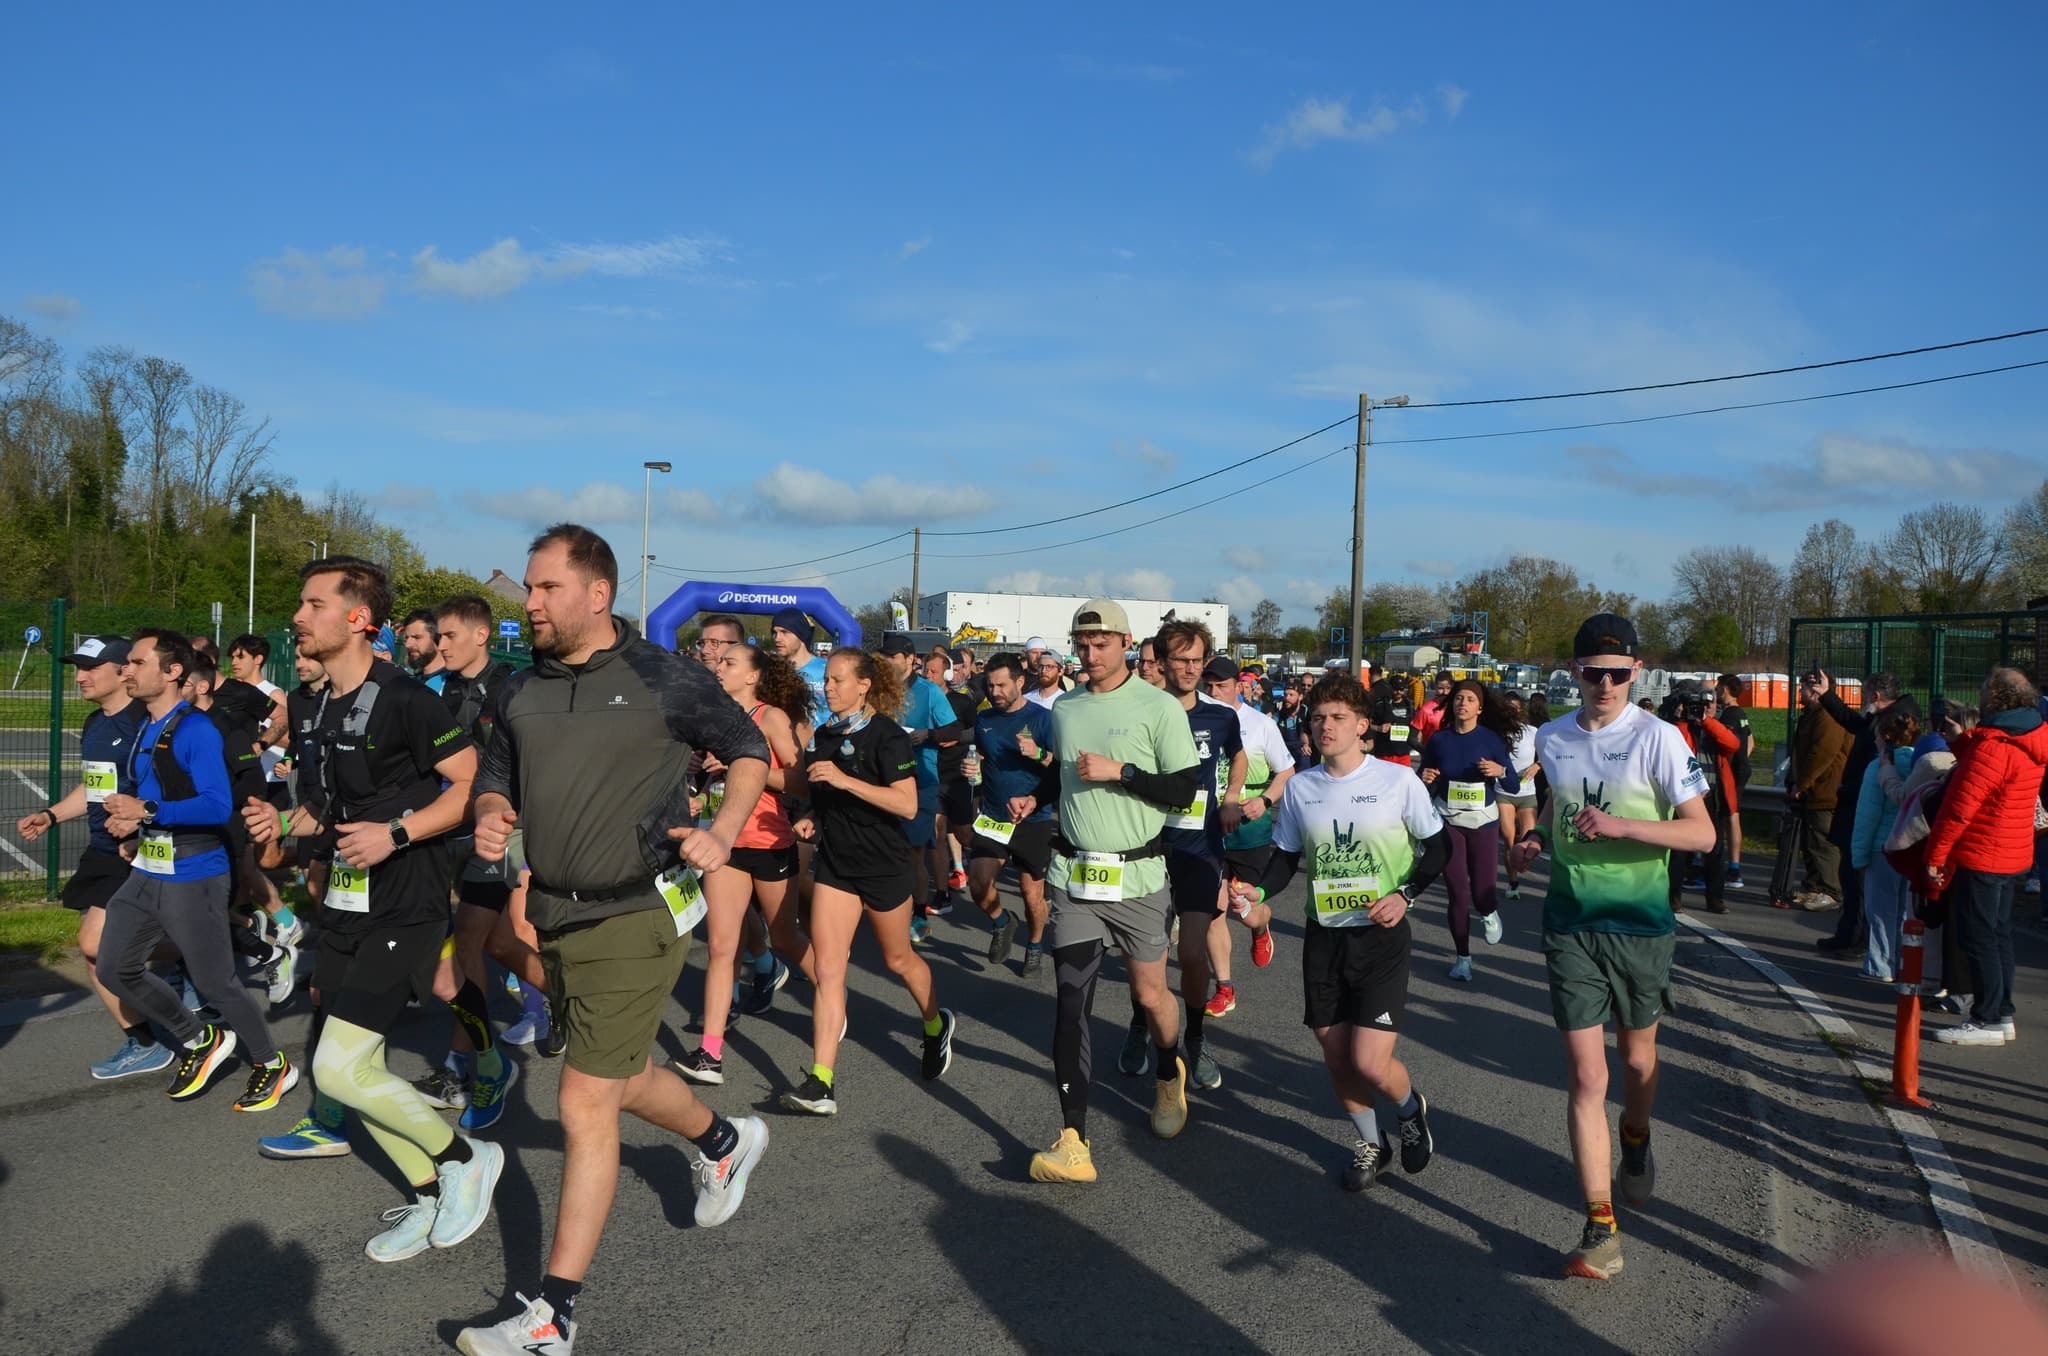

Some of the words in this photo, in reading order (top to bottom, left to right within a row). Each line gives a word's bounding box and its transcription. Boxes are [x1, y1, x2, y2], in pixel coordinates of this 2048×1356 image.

[734, 593, 797, 605] DECATHLON
[84, 775, 103, 787] 37
[1456, 791, 1477, 800] 965
[983, 820, 1004, 831] 518
[330, 871, 351, 889] 00
[1325, 894, 1370, 910] 1069
